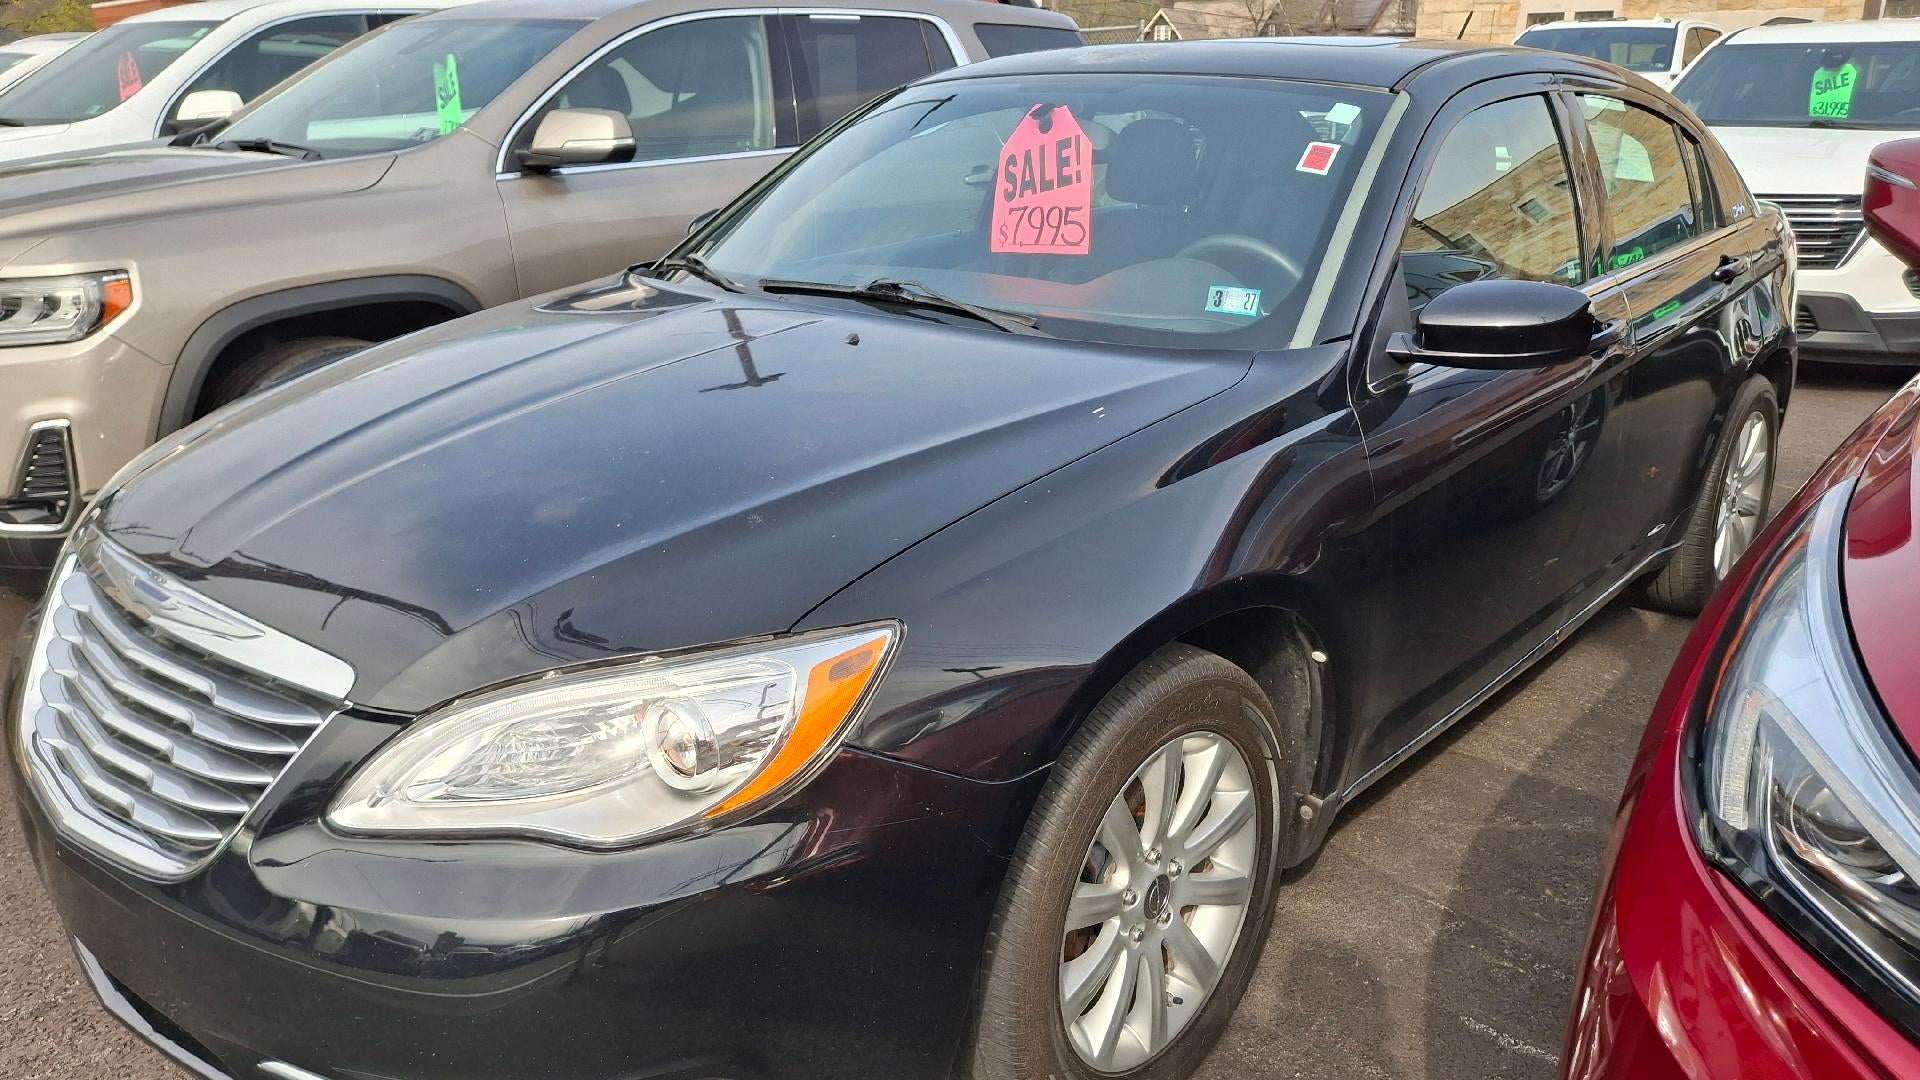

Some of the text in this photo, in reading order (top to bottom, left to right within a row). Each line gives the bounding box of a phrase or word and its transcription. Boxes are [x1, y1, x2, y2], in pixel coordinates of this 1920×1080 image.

[120, 60, 138, 91] SALE
[439, 72, 457, 110] SALE
[1814, 72, 1850, 96] SALE
[1003, 134, 1082, 203] SALE!
[1213, 290, 1223, 307] 3
[1243, 292, 1257, 310] 27
